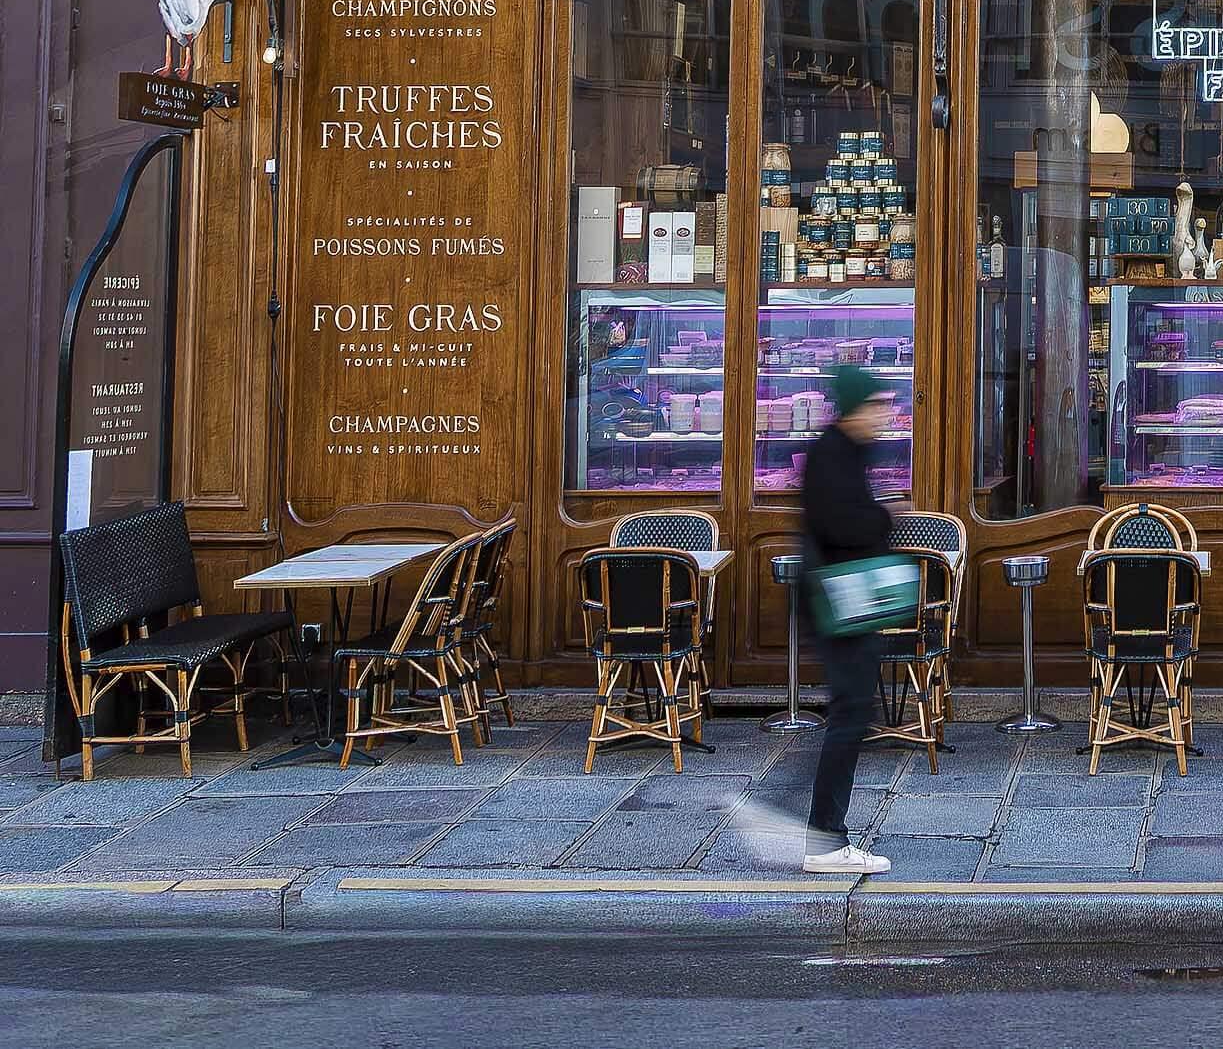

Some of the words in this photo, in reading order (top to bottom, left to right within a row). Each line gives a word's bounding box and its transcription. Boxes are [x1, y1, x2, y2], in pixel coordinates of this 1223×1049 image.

[331, 0, 497, 17] CHAMPIGNONS
[345, 28, 382, 37] SECS
[390, 28, 483, 37] SYLVESTRES
[331, 85, 494, 113] TRUFFES
[320, 118, 502, 150] FRAÎCHES
[369, 160, 387, 169] EN
[395, 160, 453, 169] SAISON
[1127, 201, 1148, 215] 130
[347, 215, 446, 226] SPÉCIALITÉS
[454, 217, 473, 226] DE
[313, 238, 421, 256] POISSONS
[431, 234, 505, 256] FUMÉS
[1129, 239, 1150, 253] 130
[312, 304, 394, 332] FOIE
[407, 304, 502, 332] GRAS
[340, 342, 384, 352] FRAIS
[393, 343, 401, 352] &
[410, 342, 474, 352] MI-CUIT
[344, 358, 394, 367] TOUTE
[402, 355, 467, 367] L'ANNÉE
[328, 415, 480, 433] CHAMPAGNES
[327, 445, 363, 454] VINS
[372, 445, 380, 454] &
[388, 445, 481, 454] SPIRITUEUX
